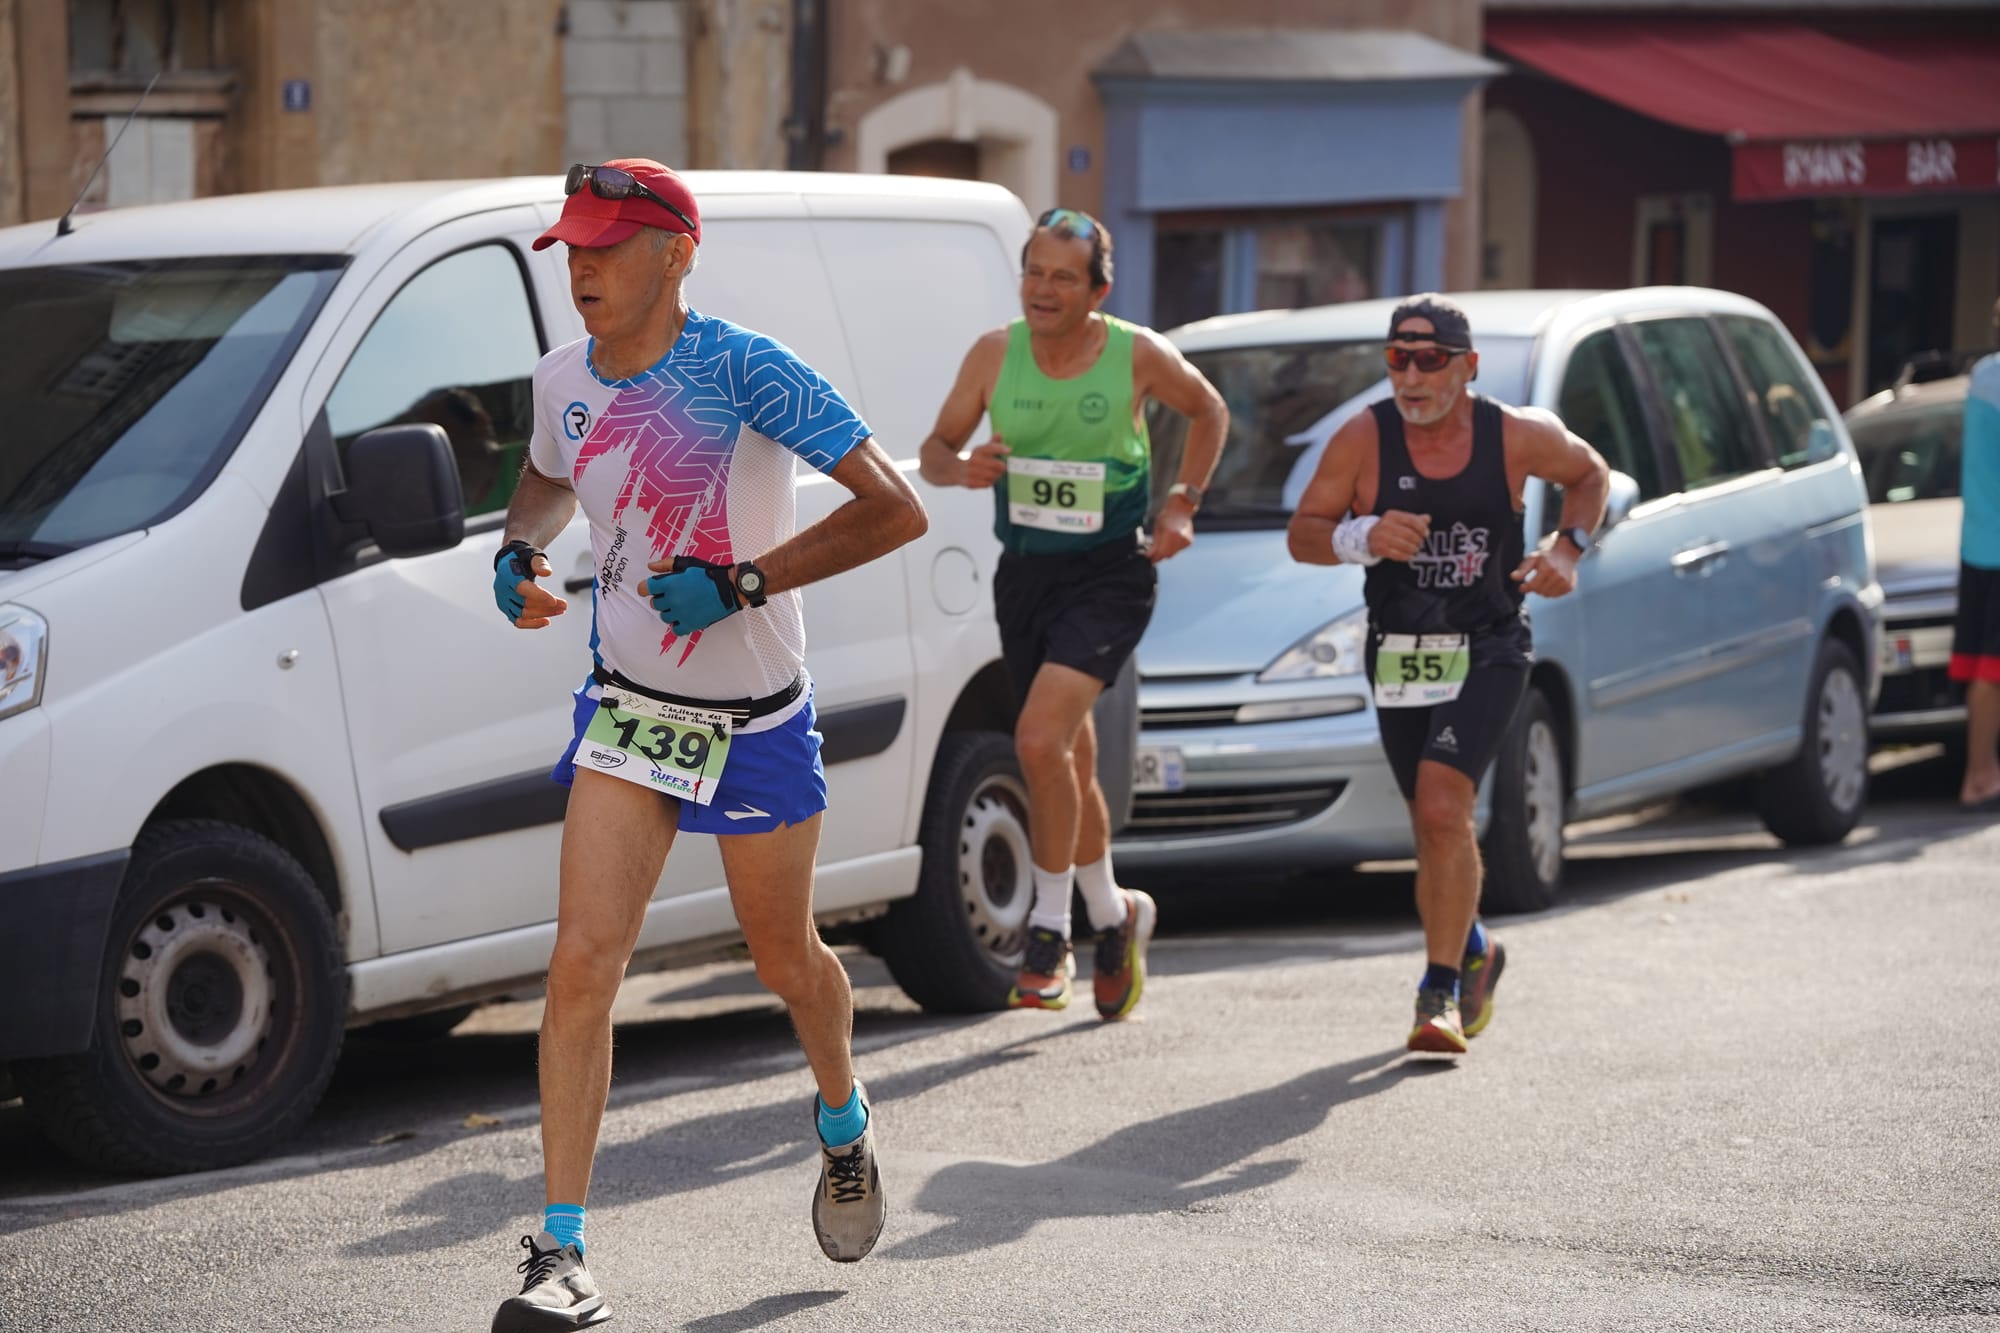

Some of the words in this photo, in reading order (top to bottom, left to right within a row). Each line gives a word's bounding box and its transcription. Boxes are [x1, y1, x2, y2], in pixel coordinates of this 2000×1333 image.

[1782, 139, 1866, 187] RYAN'S
[1906, 138, 1957, 184] BAR
[1032, 479, 1077, 509] 96
[1400, 654, 1443, 682] 55
[661, 704, 703, 719] Challenge
[708, 713, 723, 721] des
[613, 717, 709, 770] 139
[590, 750, 621, 763] BFP
[650, 769, 690, 787] TUFF'S
[651, 775, 692, 794] Aventure
